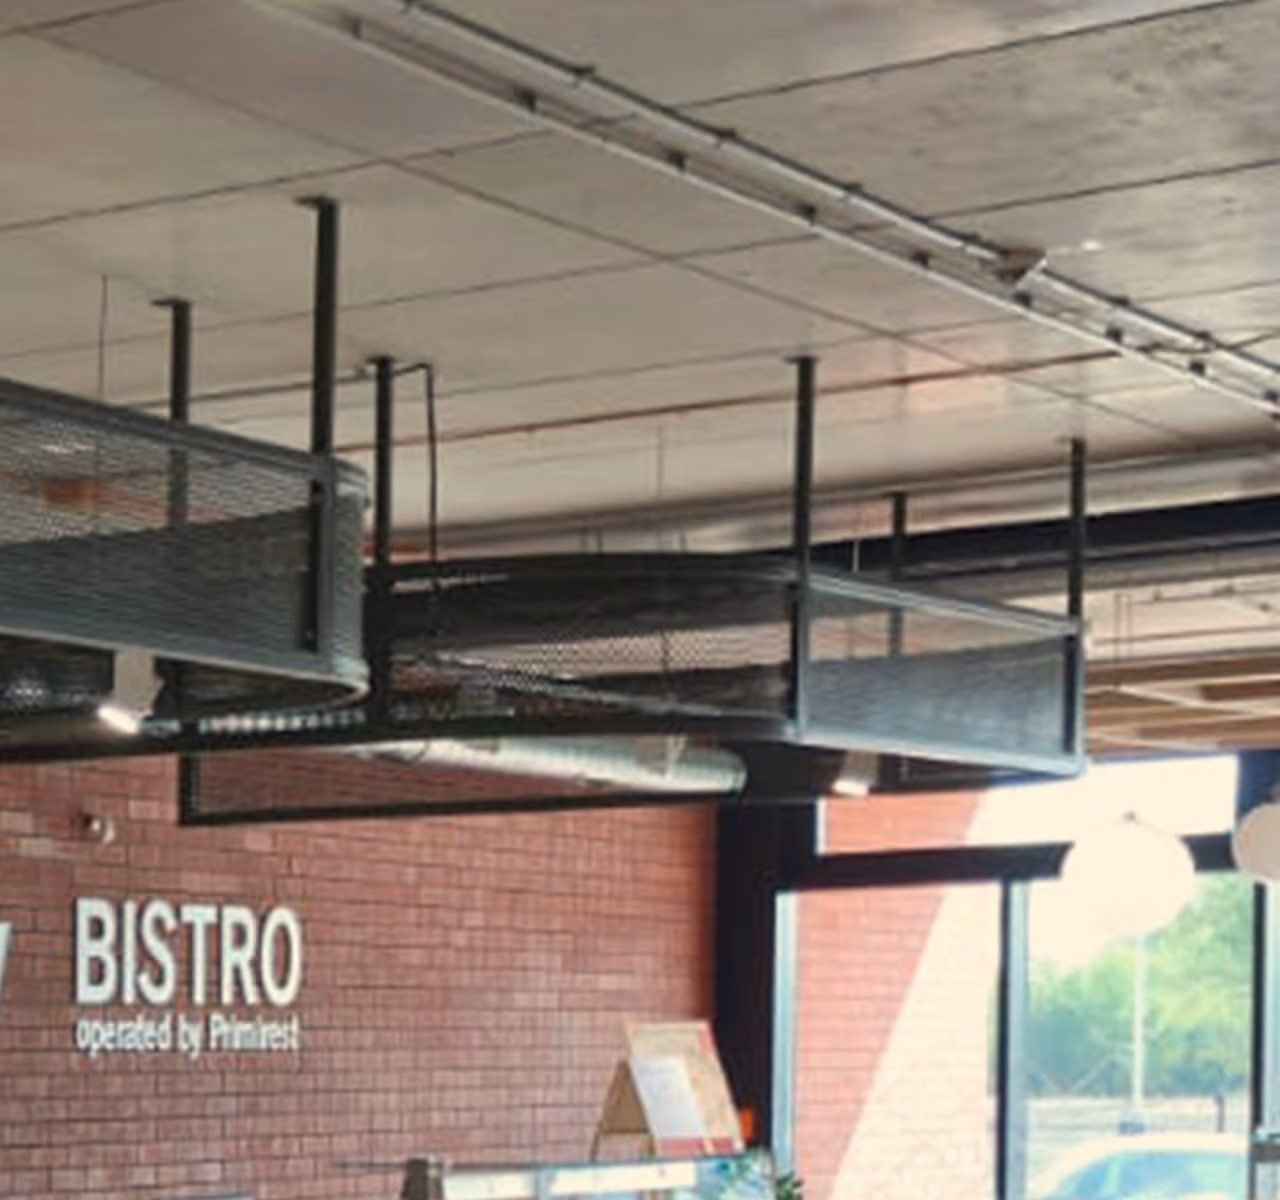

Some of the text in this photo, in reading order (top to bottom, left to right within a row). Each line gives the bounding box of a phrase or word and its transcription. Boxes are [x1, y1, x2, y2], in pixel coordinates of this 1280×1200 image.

[75, 897, 302, 1006] BISTRO
[76, 1014, 171, 1059] operated
[178, 1013, 203, 1059] by
